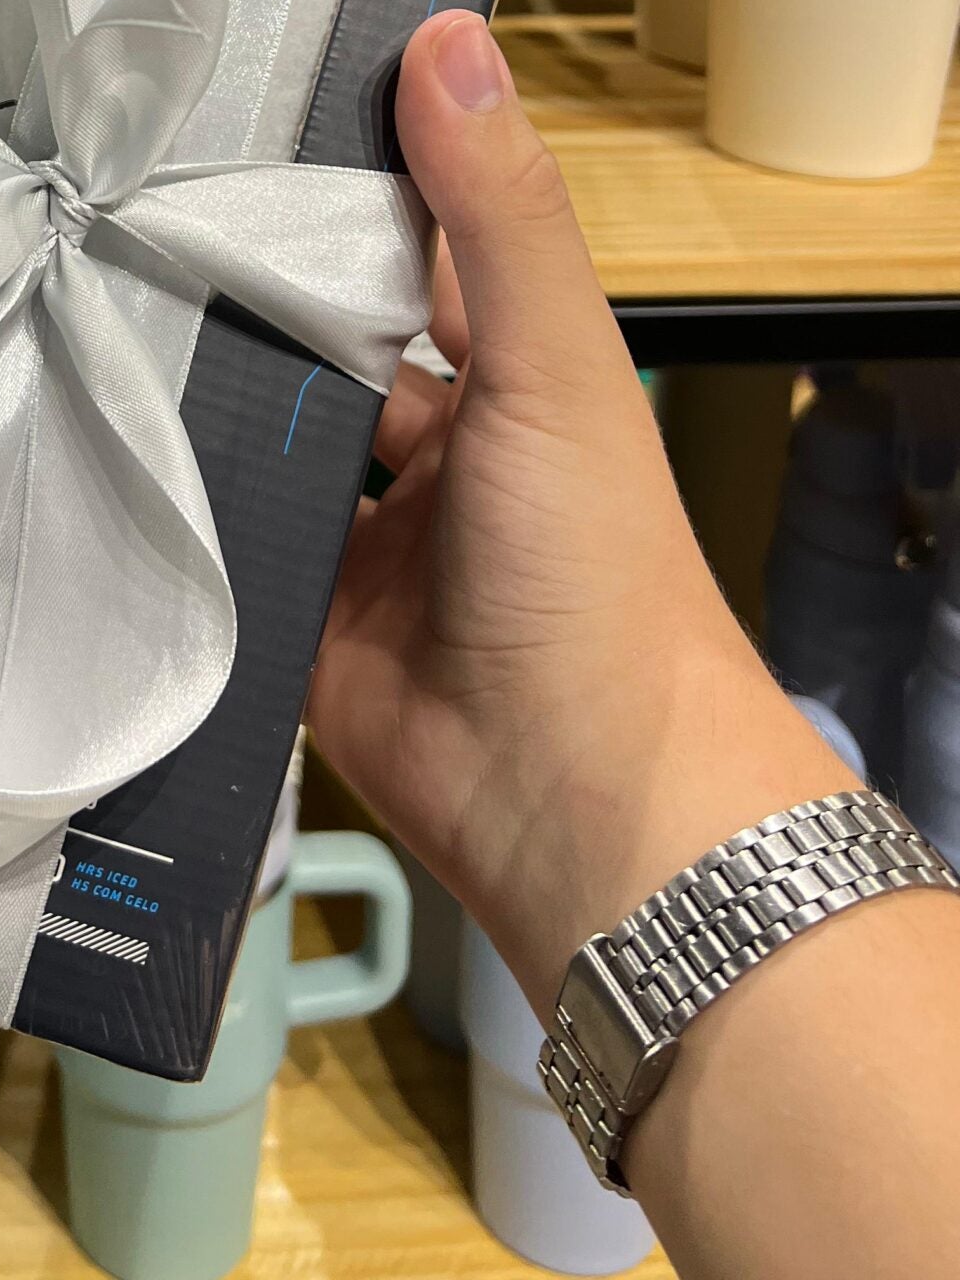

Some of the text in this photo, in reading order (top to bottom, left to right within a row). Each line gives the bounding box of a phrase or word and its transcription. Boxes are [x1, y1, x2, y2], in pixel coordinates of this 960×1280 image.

[75, 861, 104, 879] HRS
[106, 870, 138, 889] ICED
[71, 877, 160, 913] HS COM GELO
